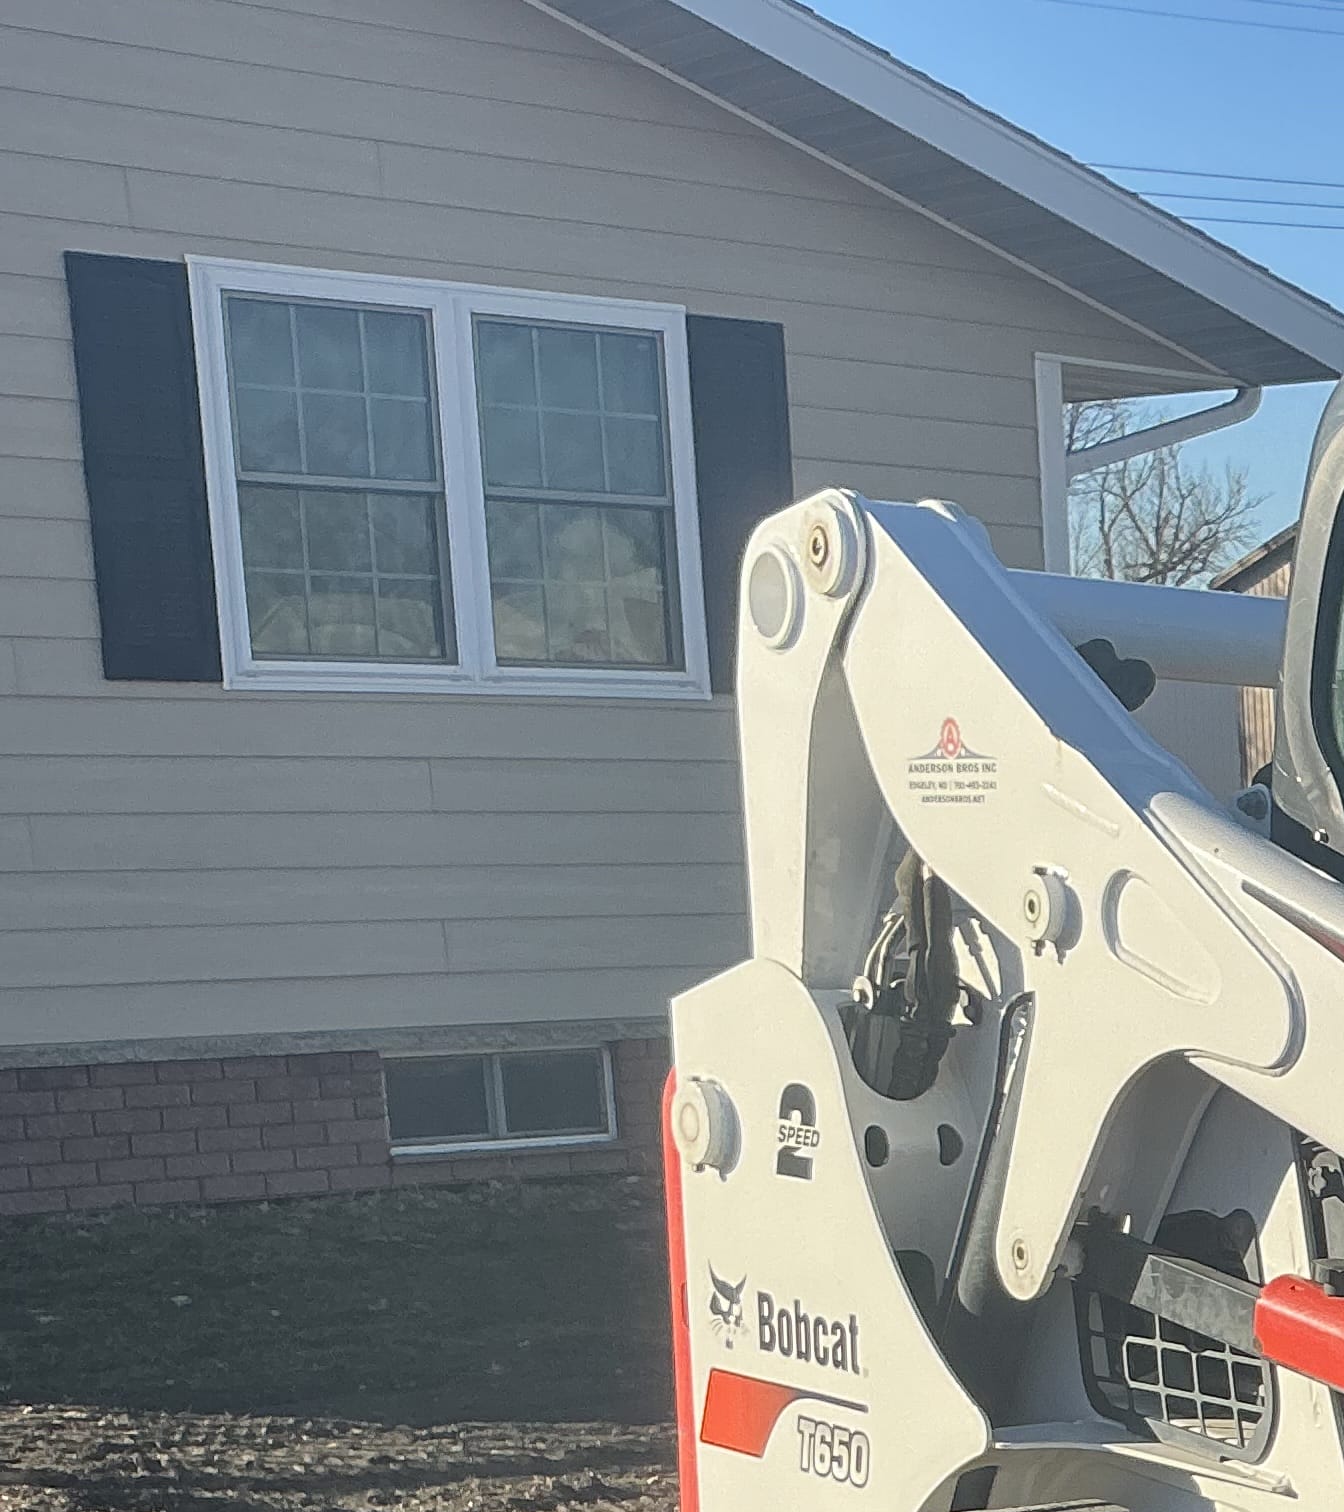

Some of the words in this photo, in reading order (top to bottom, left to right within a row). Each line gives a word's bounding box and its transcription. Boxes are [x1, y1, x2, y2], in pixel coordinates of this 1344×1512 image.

[908, 762, 953, 773] ANDERSON
[956, 762, 979, 773] BROS
[981, 762, 997, 773] INC
[778, 1124, 820, 1149] SPEED
[757, 1291, 860, 1375] Bobcat
[797, 1415, 870, 1488] T650
